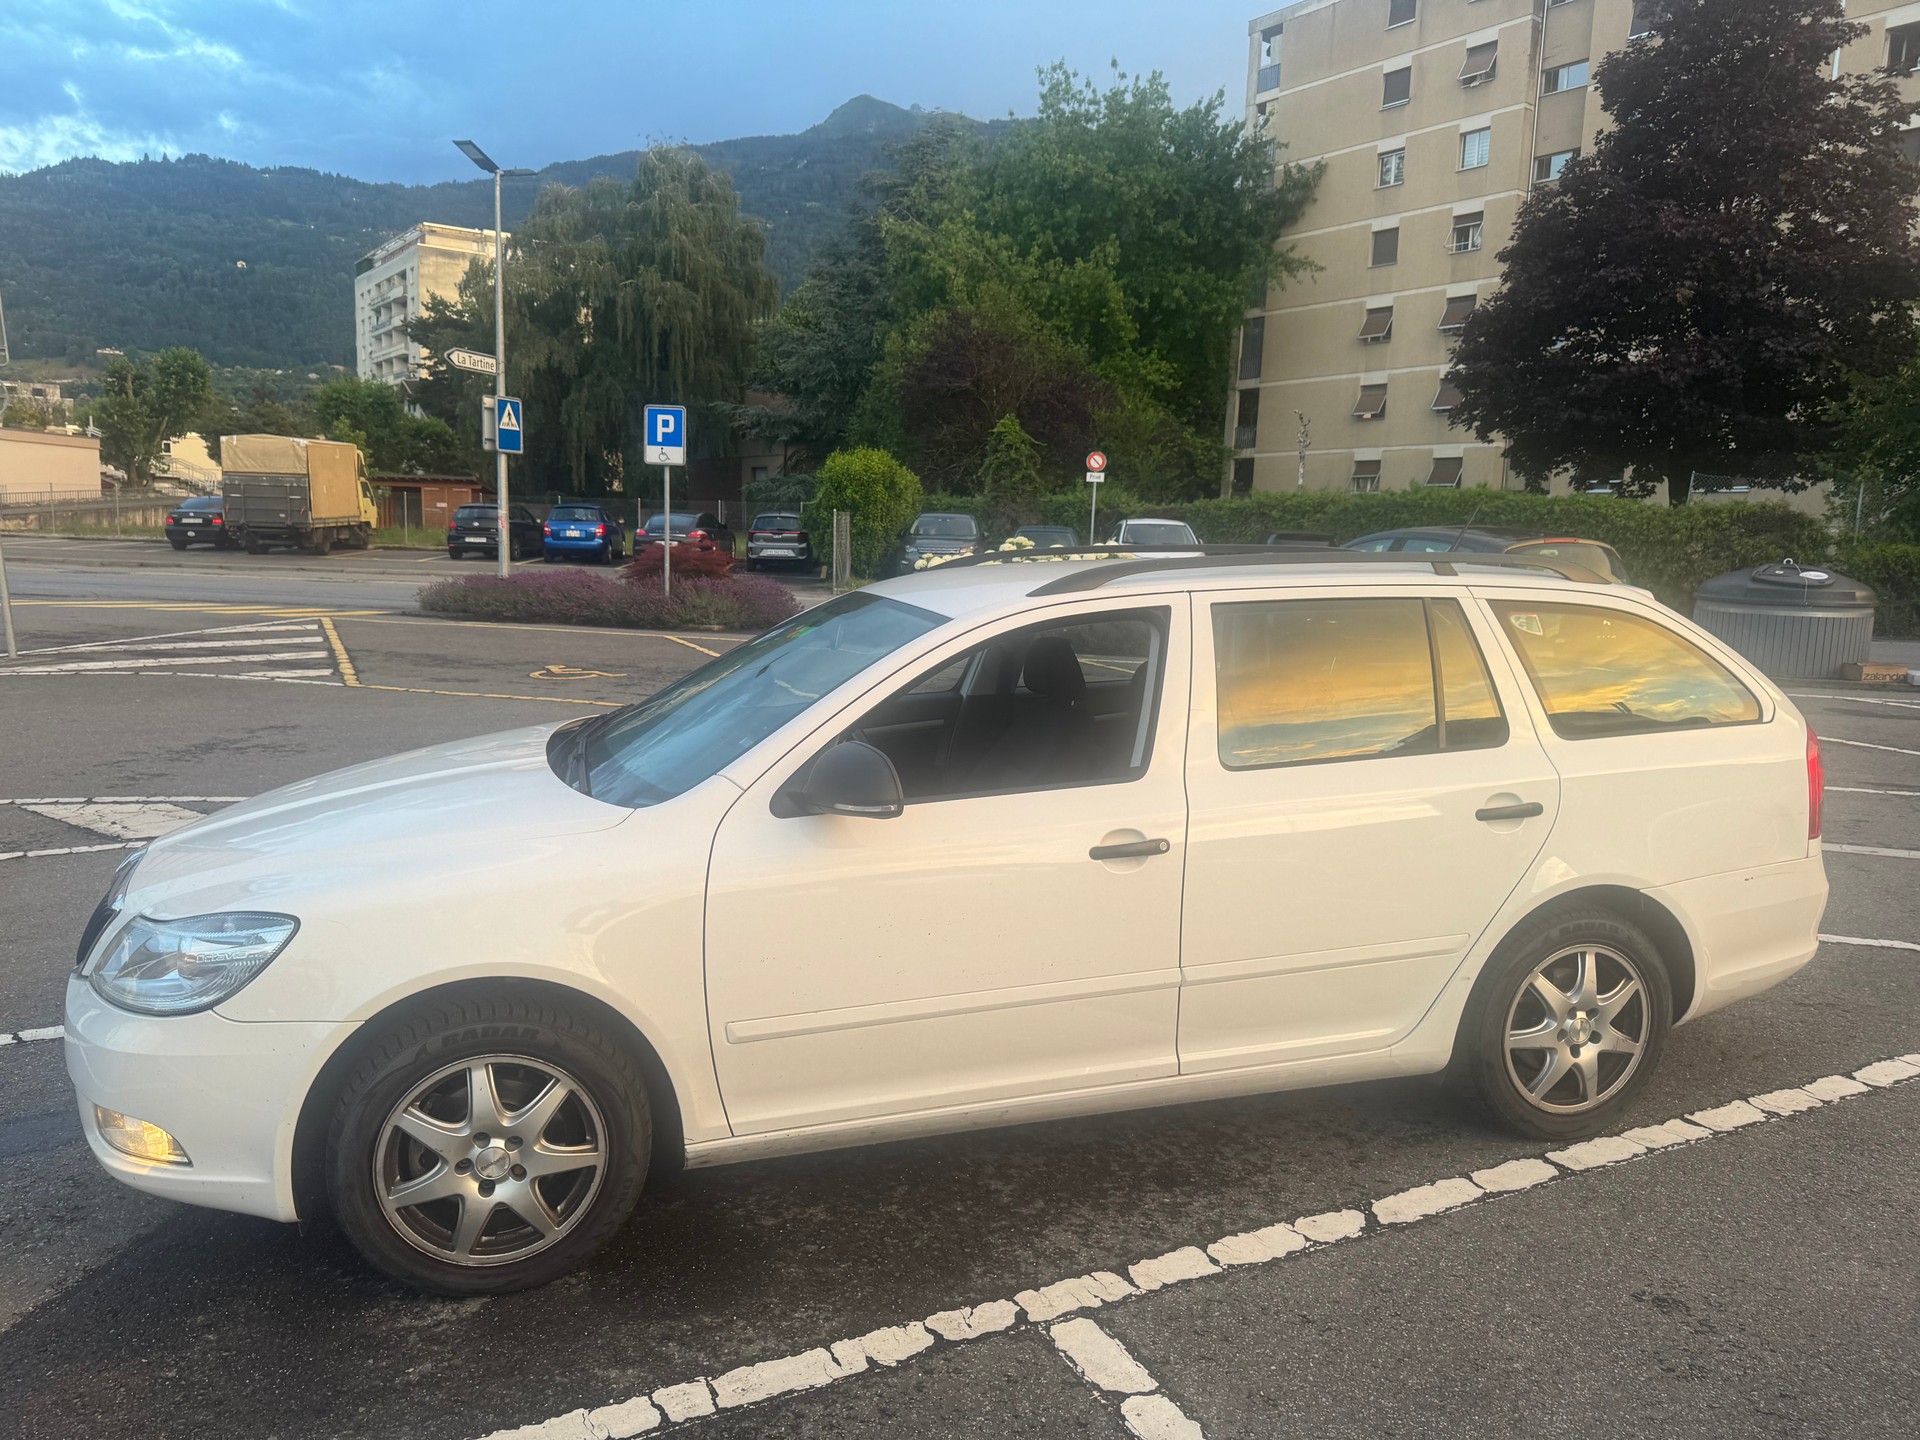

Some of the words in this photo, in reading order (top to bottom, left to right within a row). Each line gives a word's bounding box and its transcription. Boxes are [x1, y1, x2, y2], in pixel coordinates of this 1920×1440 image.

[457, 353, 466, 365] La
[468, 355, 495, 371] Tartine
[657, 414, 675, 443] P
